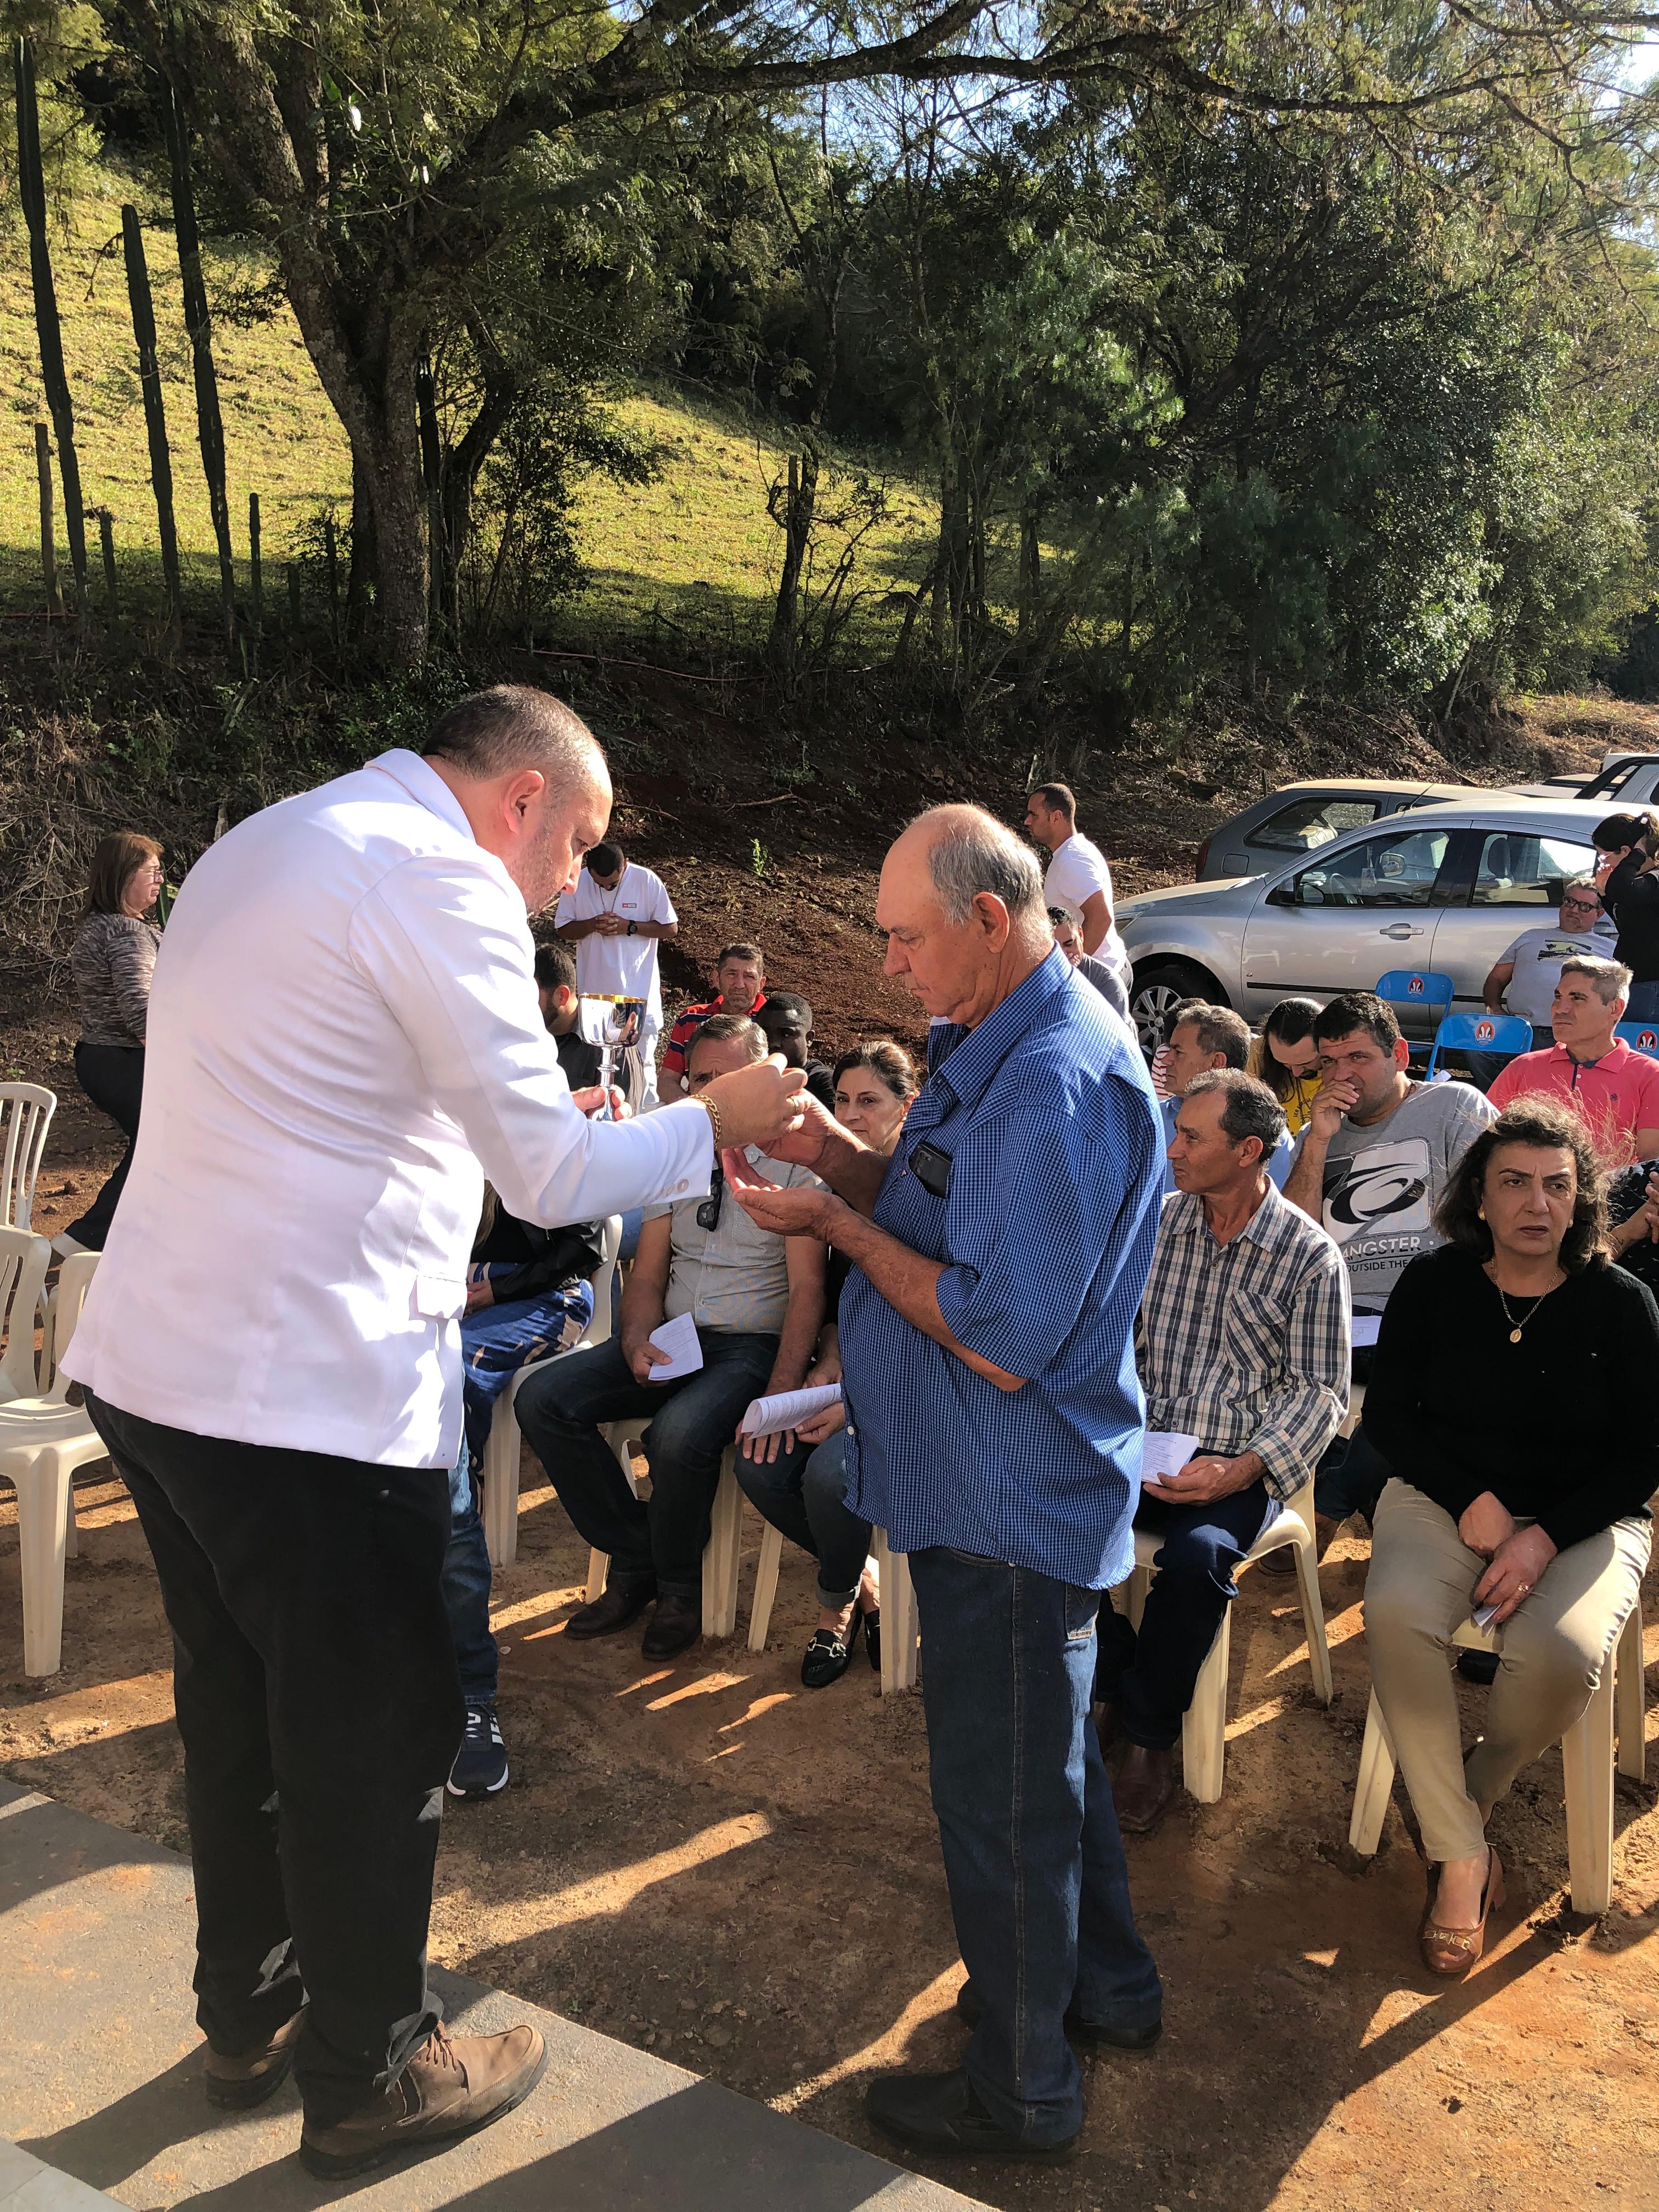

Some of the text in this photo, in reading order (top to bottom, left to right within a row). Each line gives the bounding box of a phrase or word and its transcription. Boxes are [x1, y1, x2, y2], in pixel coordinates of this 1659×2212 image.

[1343, 1236, 1422, 1261] ANGSTER
[1347, 1260, 1408, 1273] OUTSIDE THE
